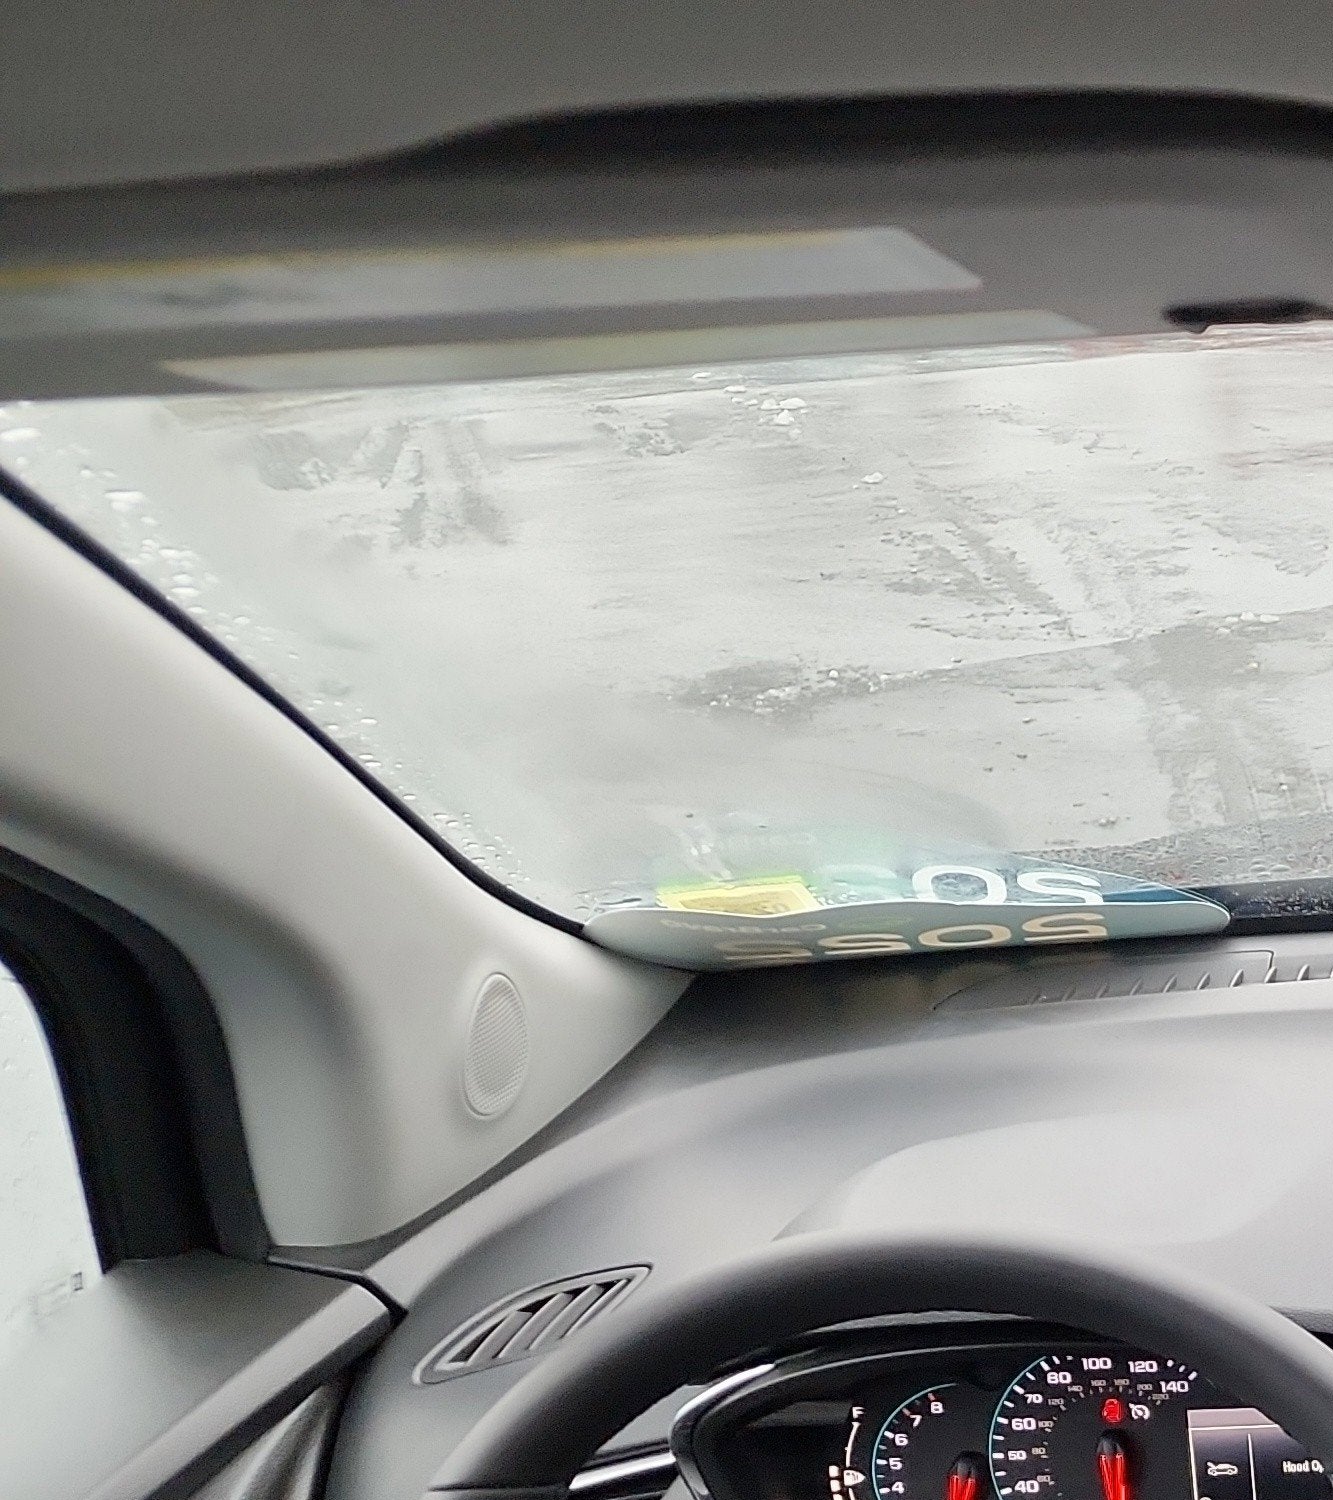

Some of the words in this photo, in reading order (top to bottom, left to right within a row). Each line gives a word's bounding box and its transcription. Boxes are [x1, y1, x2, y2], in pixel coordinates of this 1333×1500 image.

[1081, 1357, 1112, 1371] 100
[1128, 1360, 1158, 1373] 120
[1046, 1371, 1072, 1385] 80
[1159, 1380, 1189, 1393] 140
[1024, 1393, 1043, 1404] 70
[853, 1407, 865, 1419] F
[931, 1402, 944, 1414] 8
[910, 1414, 922, 1427] 7
[1011, 1417, 1037, 1431] 60
[895, 1433, 908, 1446] 6
[1007, 1450, 1027, 1461] 50
[889, 1458, 902, 1470] 5
[891, 1482, 905, 1494] 4
[1014, 1479, 1039, 1493] 40
